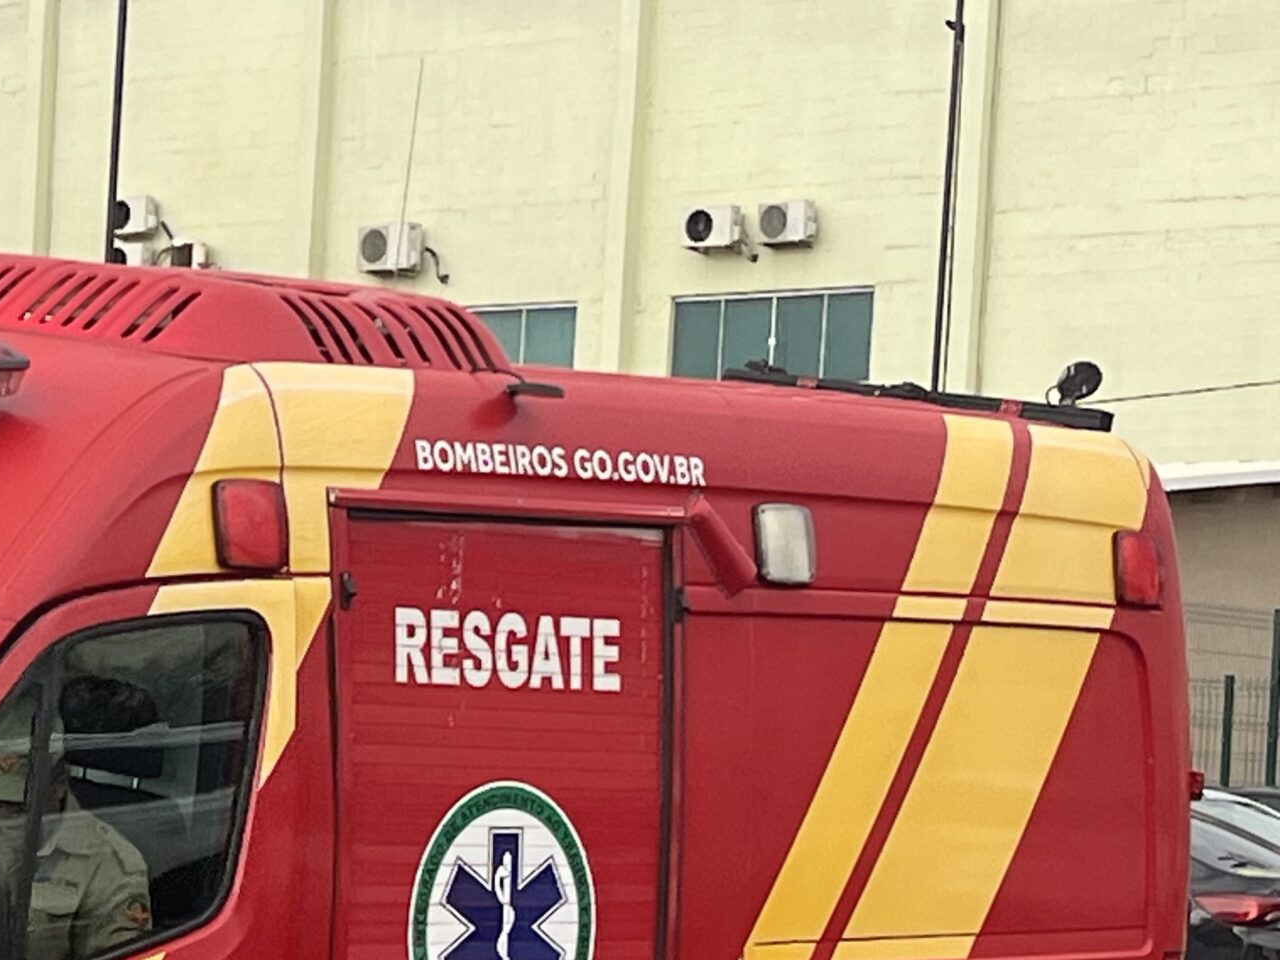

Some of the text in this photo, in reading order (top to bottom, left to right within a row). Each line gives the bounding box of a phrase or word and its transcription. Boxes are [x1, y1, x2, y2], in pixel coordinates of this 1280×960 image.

[415, 439, 706, 486] BOMBEIROS GO.GOV.BR
[395, 607, 620, 692] RESGATE
